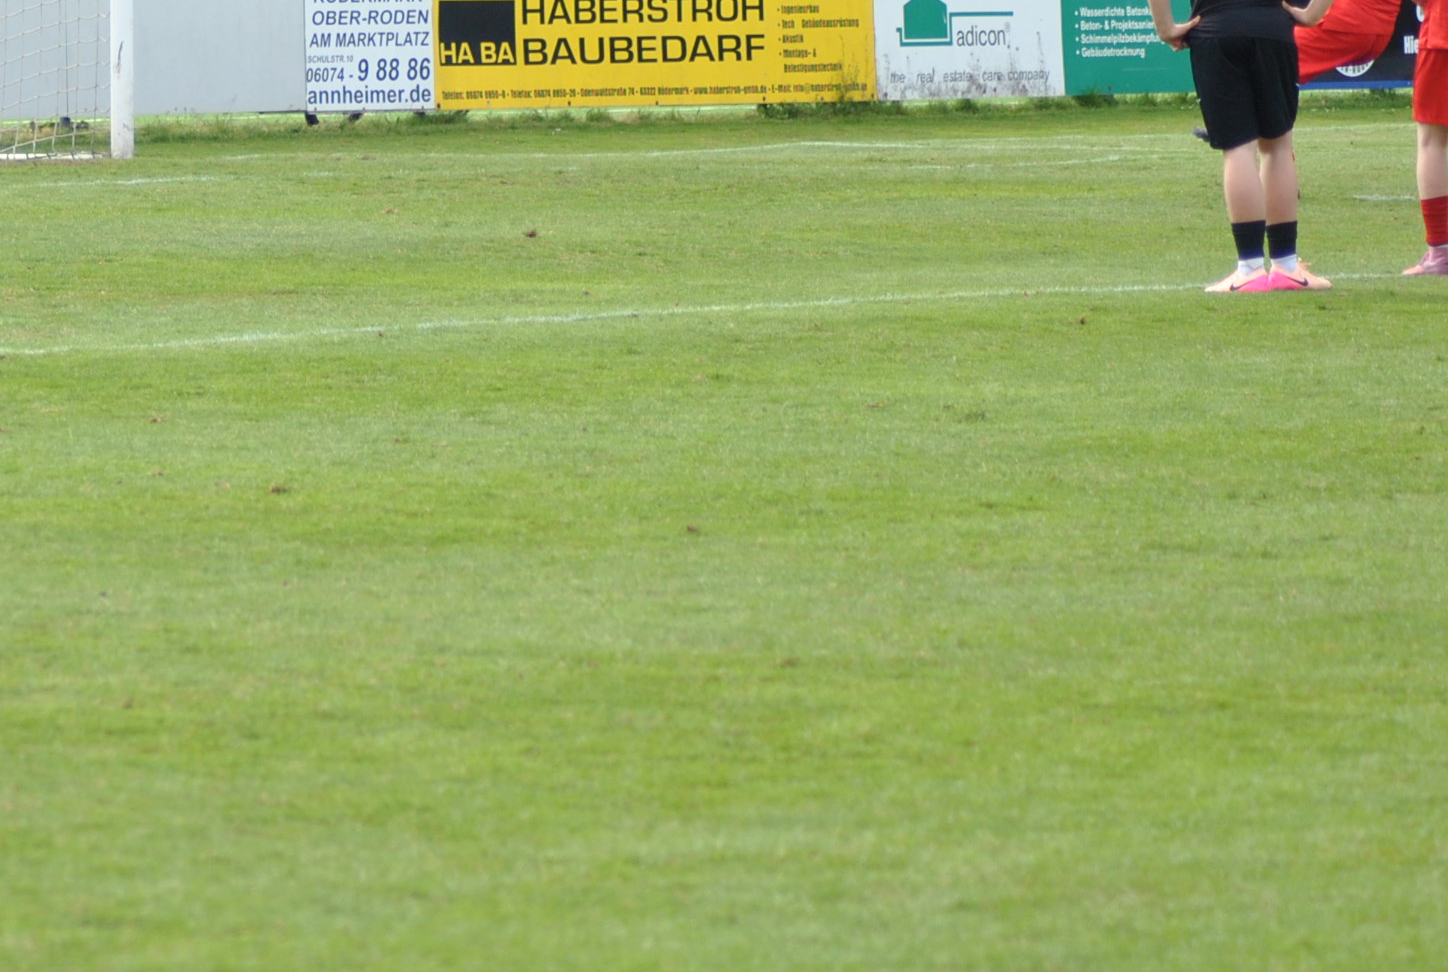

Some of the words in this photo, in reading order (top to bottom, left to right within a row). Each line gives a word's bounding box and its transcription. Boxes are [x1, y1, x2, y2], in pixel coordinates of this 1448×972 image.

[312, 10, 429, 26] OBER-RODEN
[1080, 7, 1125, 17] Wasserdichte
[1126, 6, 1152, 17] Betonk
[1080, 20, 1102, 31] Beton-
[1104, 19, 1110, 30] &
[309, 33, 332, 48] AM
[335, 32, 430, 48] MARKTPLATZ
[440, 42, 474, 65] HA
[480, 41, 515, 64] BA
[523, 34, 765, 66] BAUBEDARF
[1081, 46, 1145, 59] Gebäudetrocknung
[306, 68, 345, 82] 06074
[358, 59, 369, 81] 9
[376, 58, 400, 81] 88
[407, 58, 431, 81] 86
[890, 72, 906, 84] the
[917, 67, 935, 84] real
[943, 69, 971, 83] estate
[982, 70, 1002, 82] care
[1008, 70, 1050, 84] company
[308, 84, 431, 104] annheimer.de
